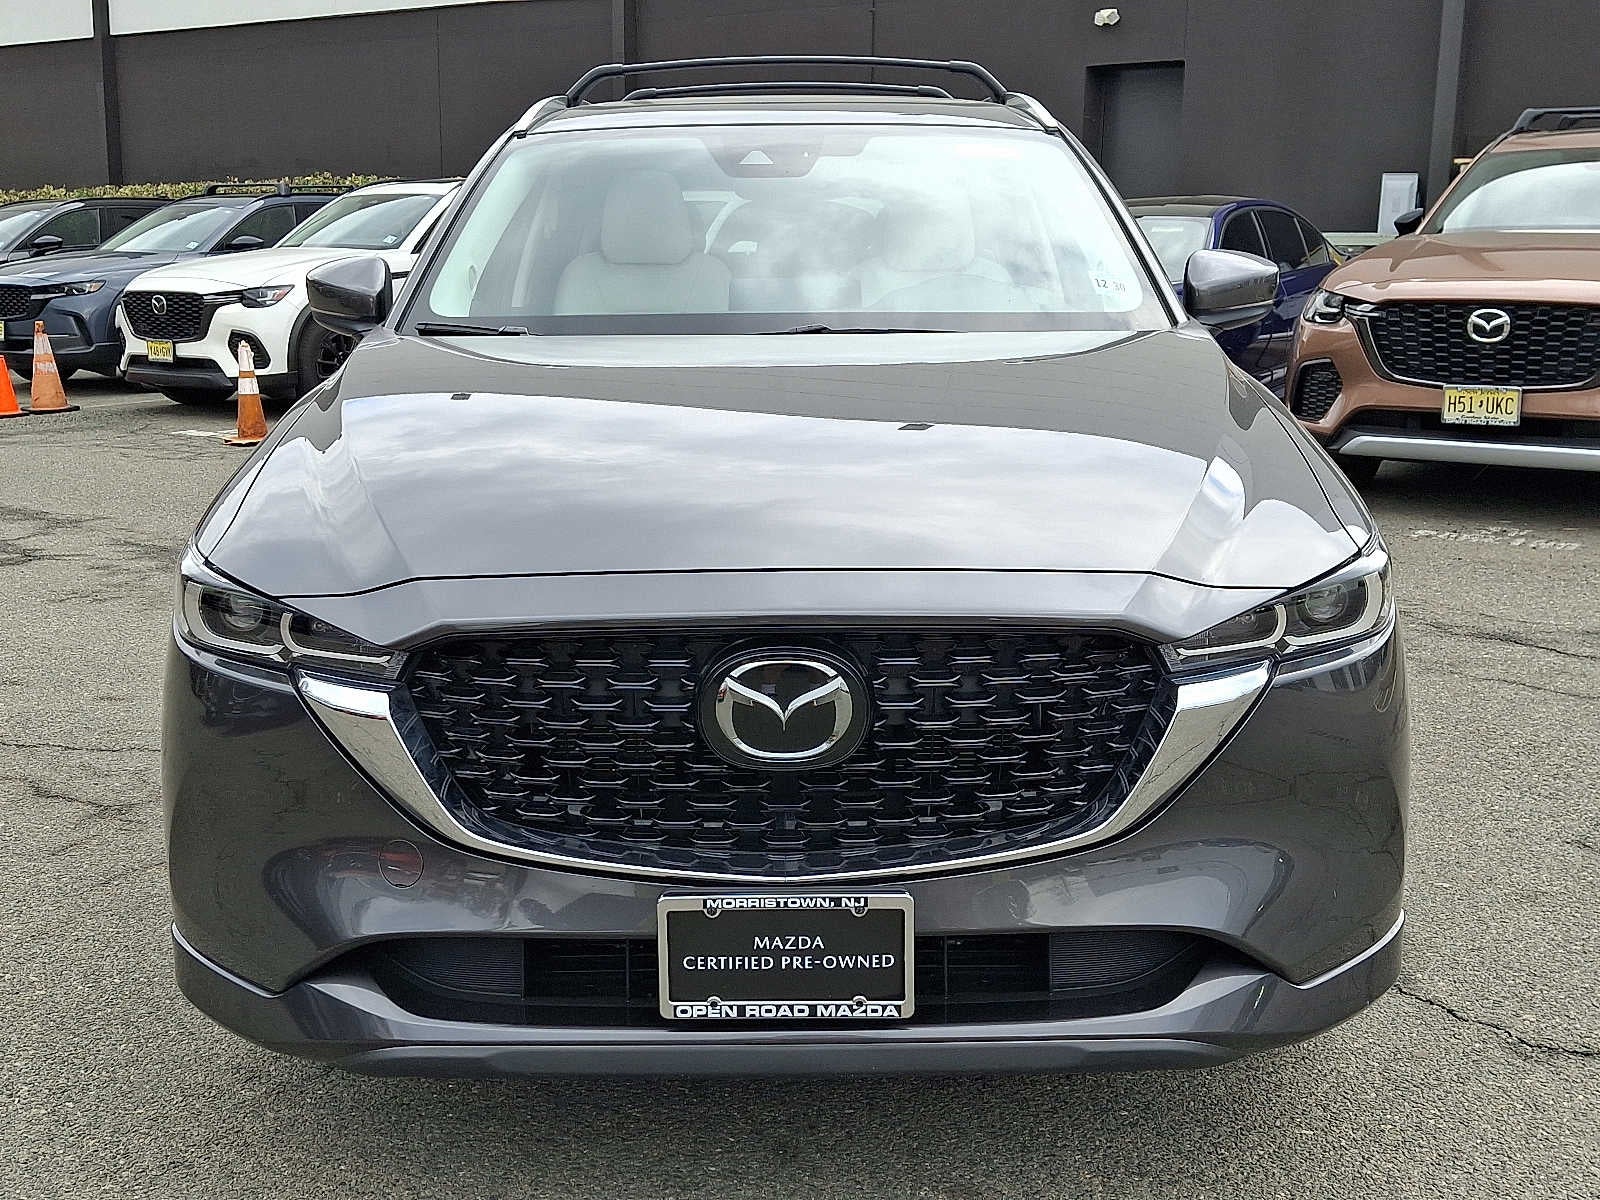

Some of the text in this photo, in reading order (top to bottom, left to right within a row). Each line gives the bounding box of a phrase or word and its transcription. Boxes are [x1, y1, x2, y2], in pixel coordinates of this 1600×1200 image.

[706, 897, 865, 909] MORRISTOWN, NJ
[753, 936, 825, 951] MAZDA
[683, 954, 895, 970] CERTIFIED PRE-OWNED
[676, 1006, 900, 1018] OPEN ROAD MAZDA
